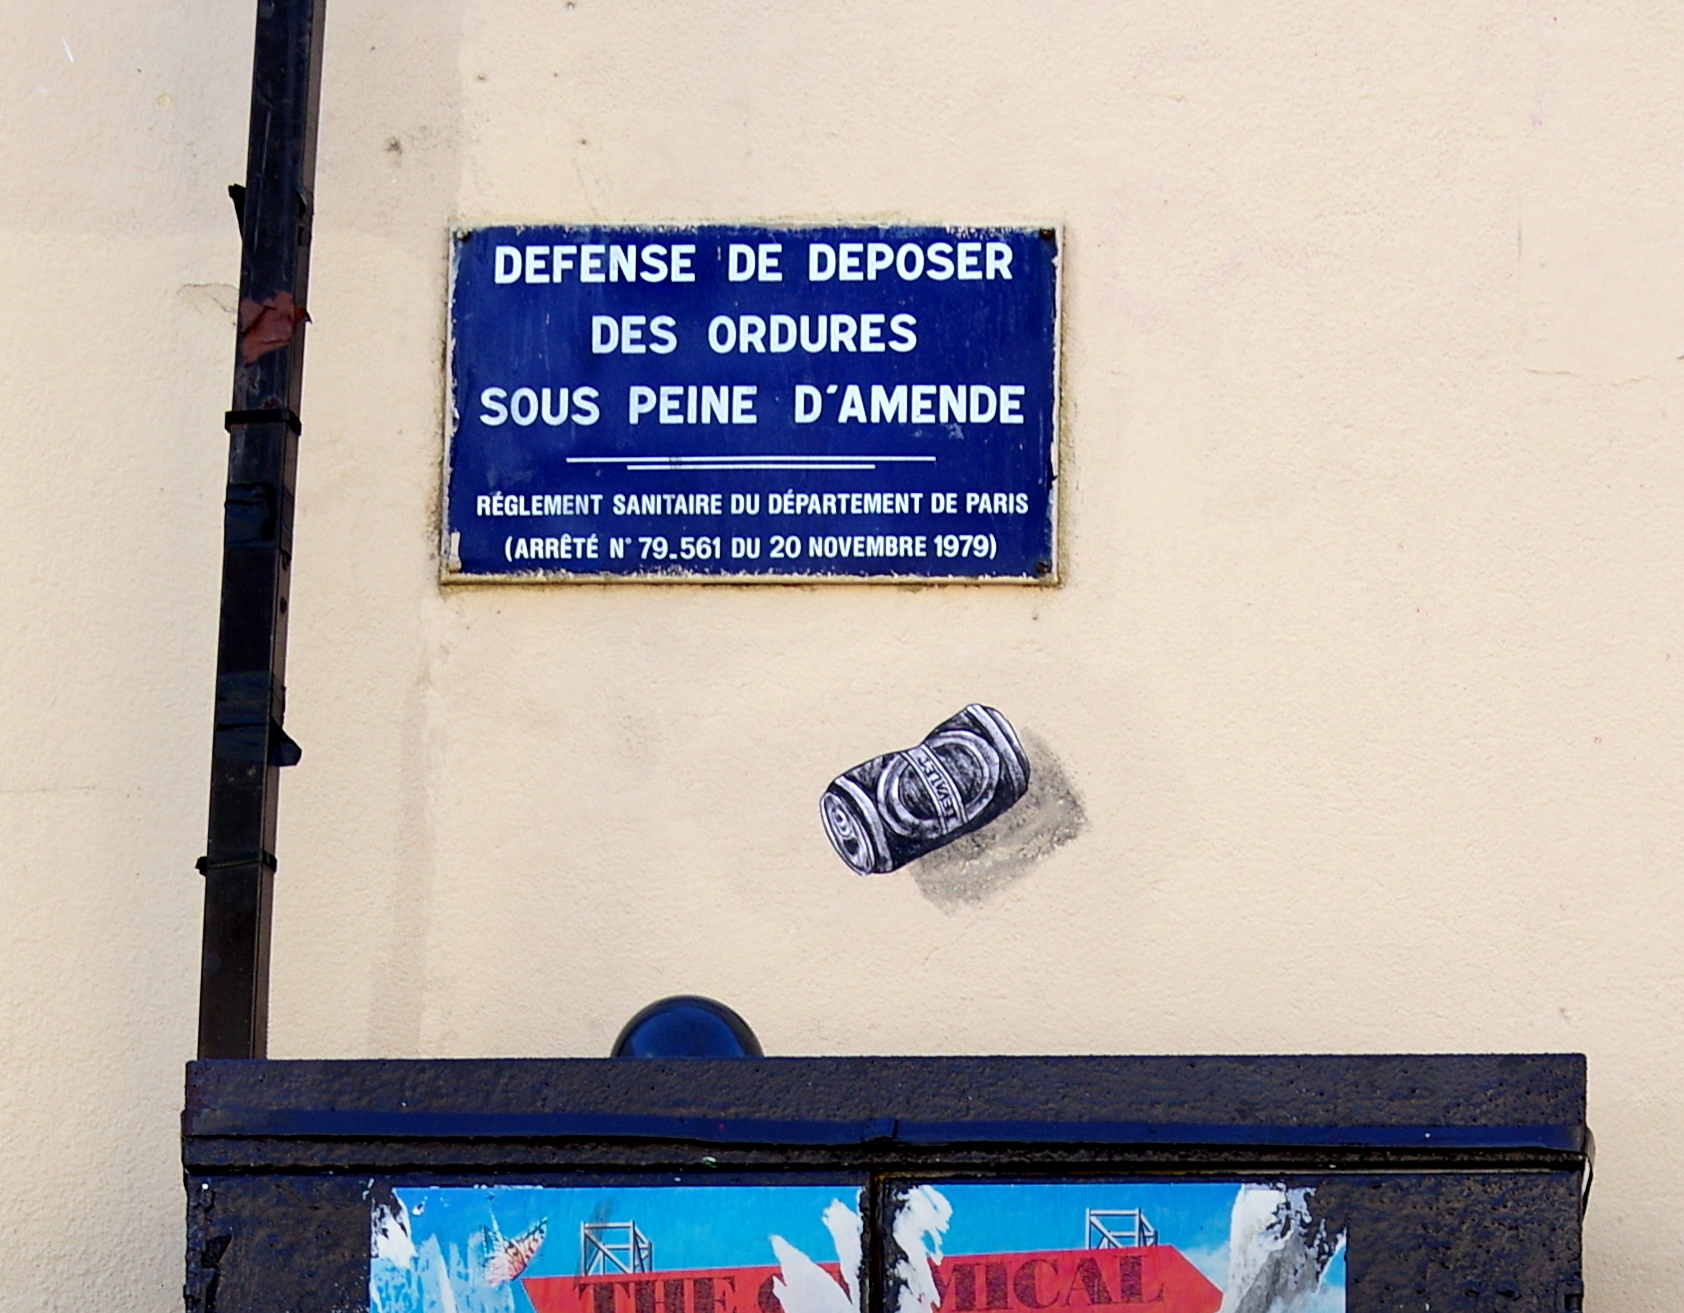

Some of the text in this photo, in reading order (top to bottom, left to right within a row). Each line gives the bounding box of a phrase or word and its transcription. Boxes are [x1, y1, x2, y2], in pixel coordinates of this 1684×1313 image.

[493, 242, 1014, 284] DEFENSE DE DEPOSER
[591, 313, 917, 354] DES ORDURES
[478, 384, 1026, 426] SOUS PEINE D'AMENDE
[612, 493, 723, 516] SANITAIRE
[731, 493, 760, 515] DU
[768, 488, 924, 515] DÉPARTEMENT
[931, 493, 958, 514] DE
[966, 492, 1029, 514] PARIS
[504, 532, 600, 563] (ARRÊTÉ
[731, 537, 761, 559] DU
[769, 535, 802, 559] 20
[808, 535, 927, 558] NOVEMBRE
[933, 532, 997, 560] 1979)
